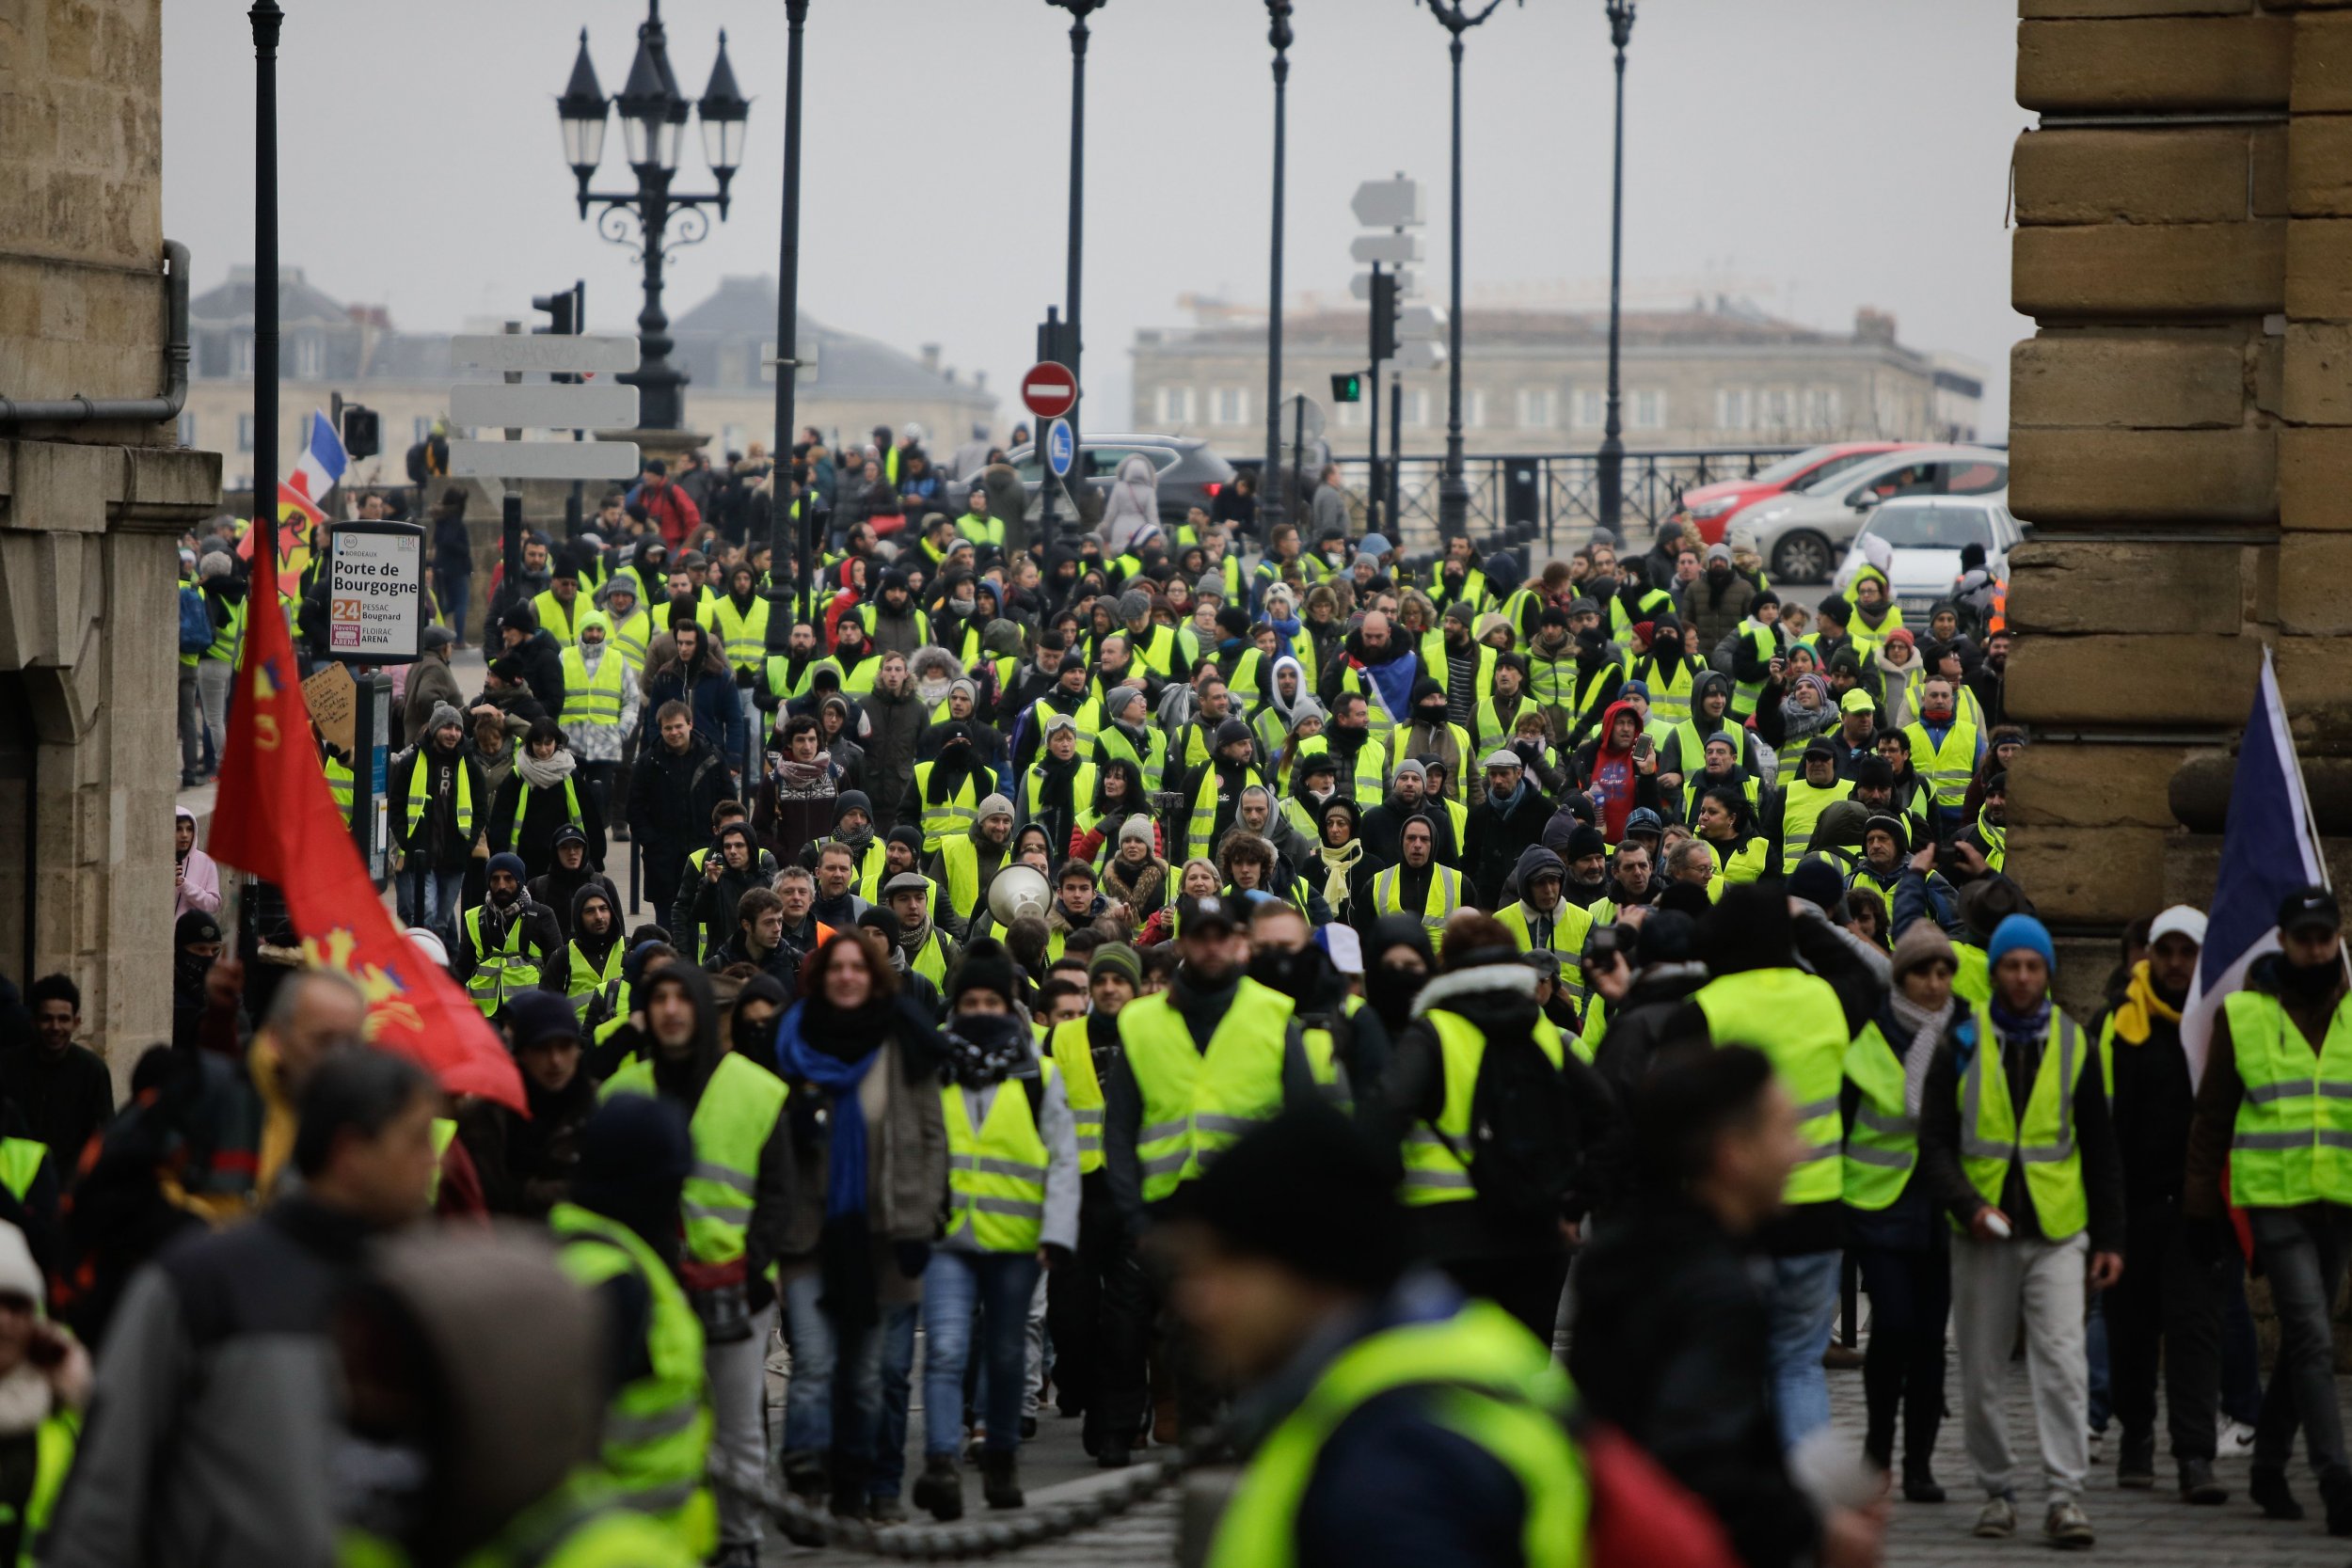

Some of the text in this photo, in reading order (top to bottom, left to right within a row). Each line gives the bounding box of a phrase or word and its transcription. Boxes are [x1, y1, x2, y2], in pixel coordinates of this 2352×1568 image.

[335, 561, 399, 577] Porte de
[334, 577, 418, 596] Bourgogne
[333, 601, 359, 620] 24
[362, 603, 389, 611] PESSAC
[362, 612, 401, 622] Bougnard
[362, 627, 392, 636] FLOIRAC
